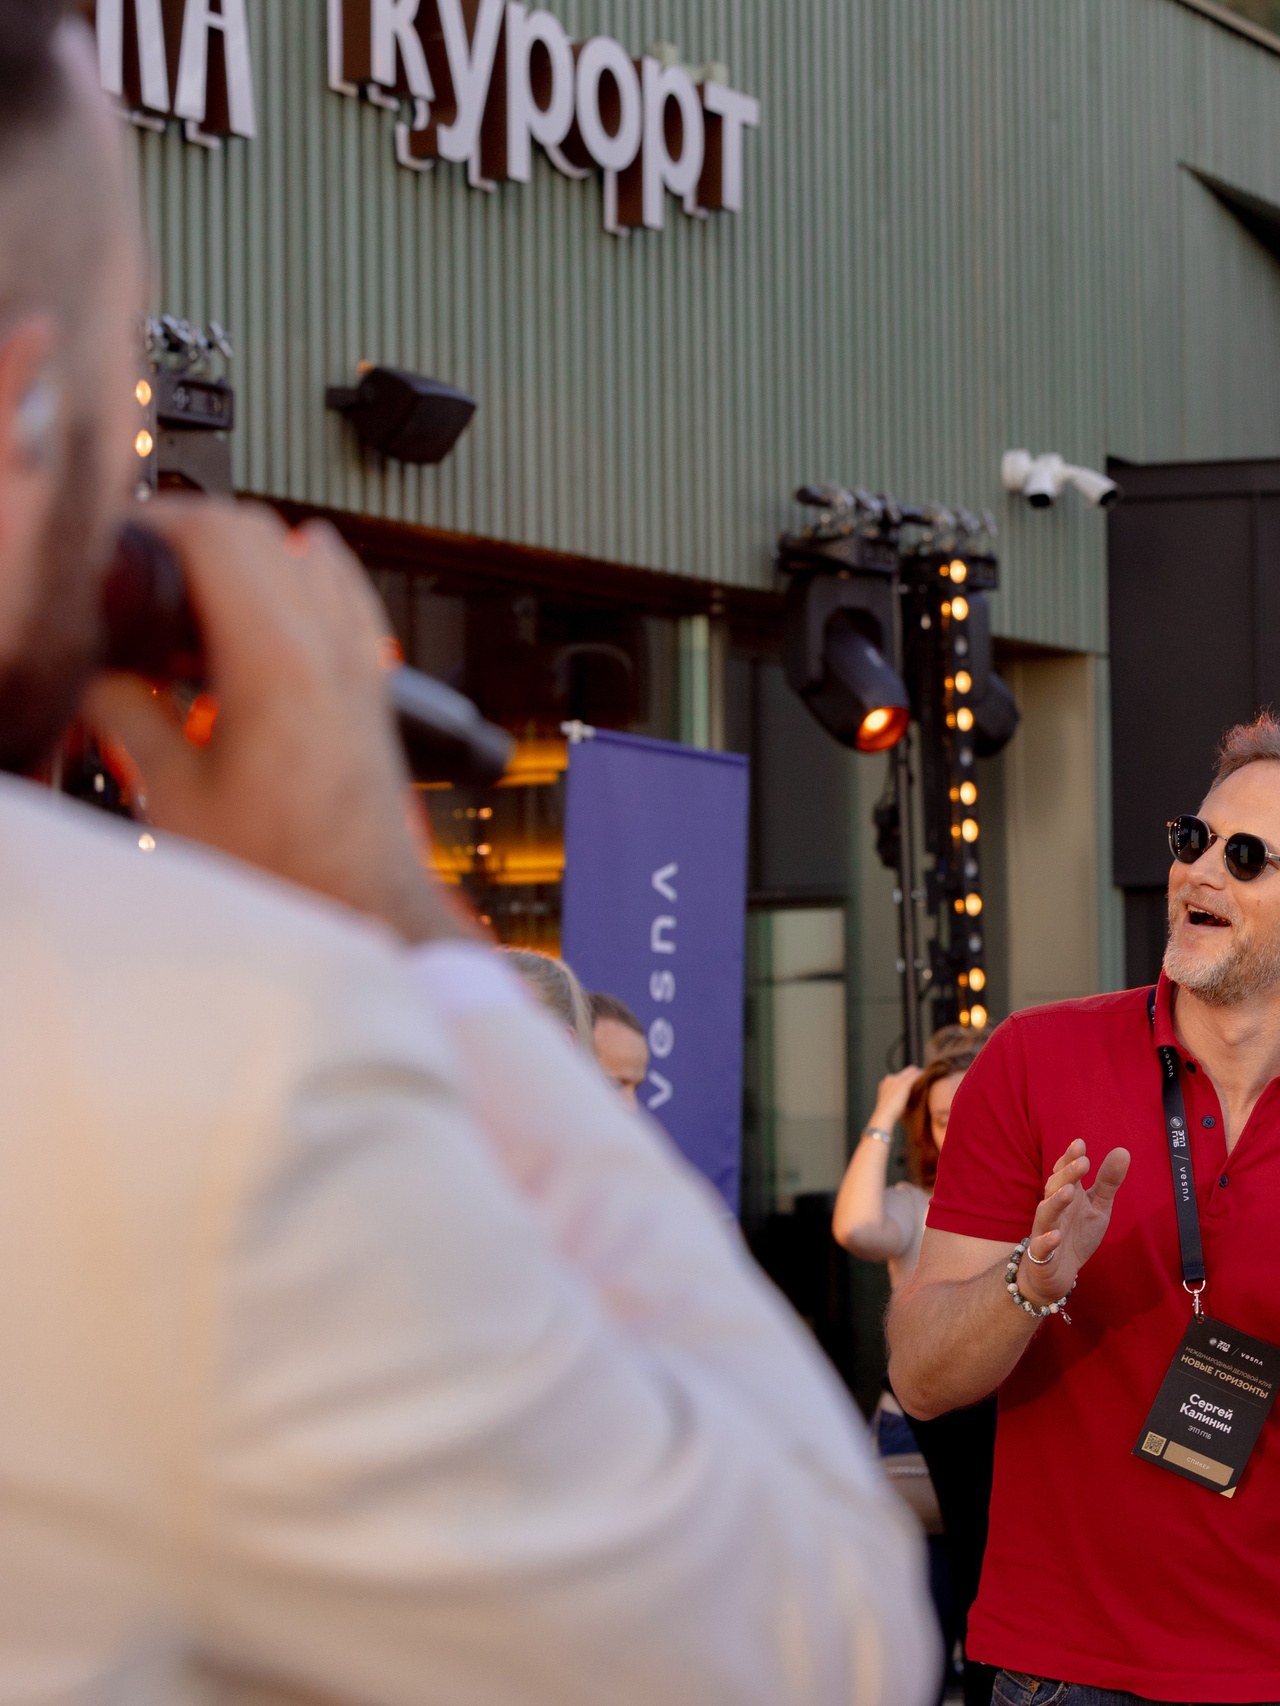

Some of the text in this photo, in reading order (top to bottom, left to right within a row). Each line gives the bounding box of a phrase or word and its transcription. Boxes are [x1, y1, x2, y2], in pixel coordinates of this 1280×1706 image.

[1180, 1354, 1269, 1399] НОВЫЕ ГОРИЗОНТЫ
[1184, 1346, 1233, 1371] МЕЖДУНАРОДНЫЙ
[1232, 1367, 1259, 1383] ДЕЛОВОЙ
[1179, 1402, 1232, 1434] Калинин
[1189, 1393, 1234, 1421] Сергей
[1187, 1425, 1213, 1440] ЭТП ГПБ
[1186, 1456, 1211, 1471] СПИКЕР
